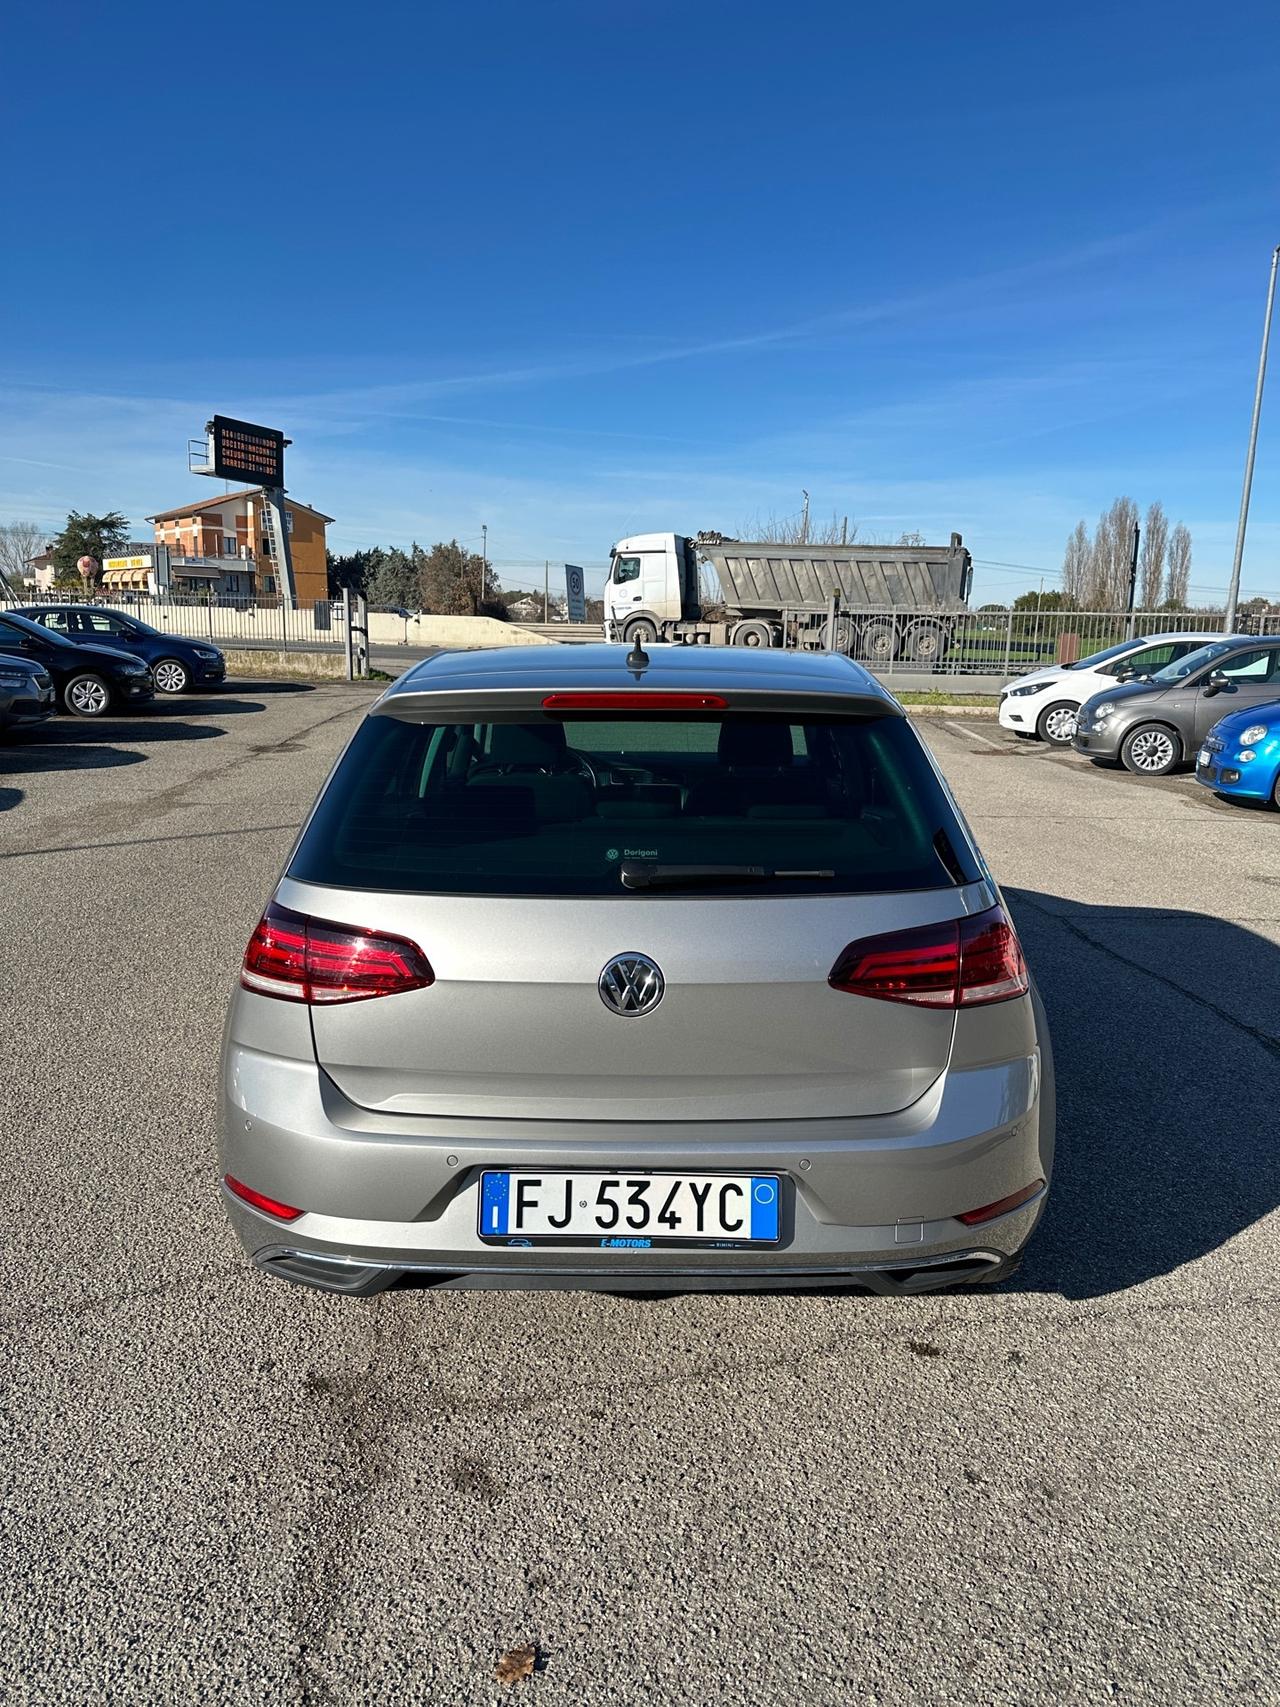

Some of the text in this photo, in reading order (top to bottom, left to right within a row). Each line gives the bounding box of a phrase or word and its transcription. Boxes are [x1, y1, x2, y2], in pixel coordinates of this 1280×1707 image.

[516, 1179, 573, 1228] FJ
[595, 1180, 744, 1232] 534YC
[600, 1238, 651, 1248] E-MOTORS
